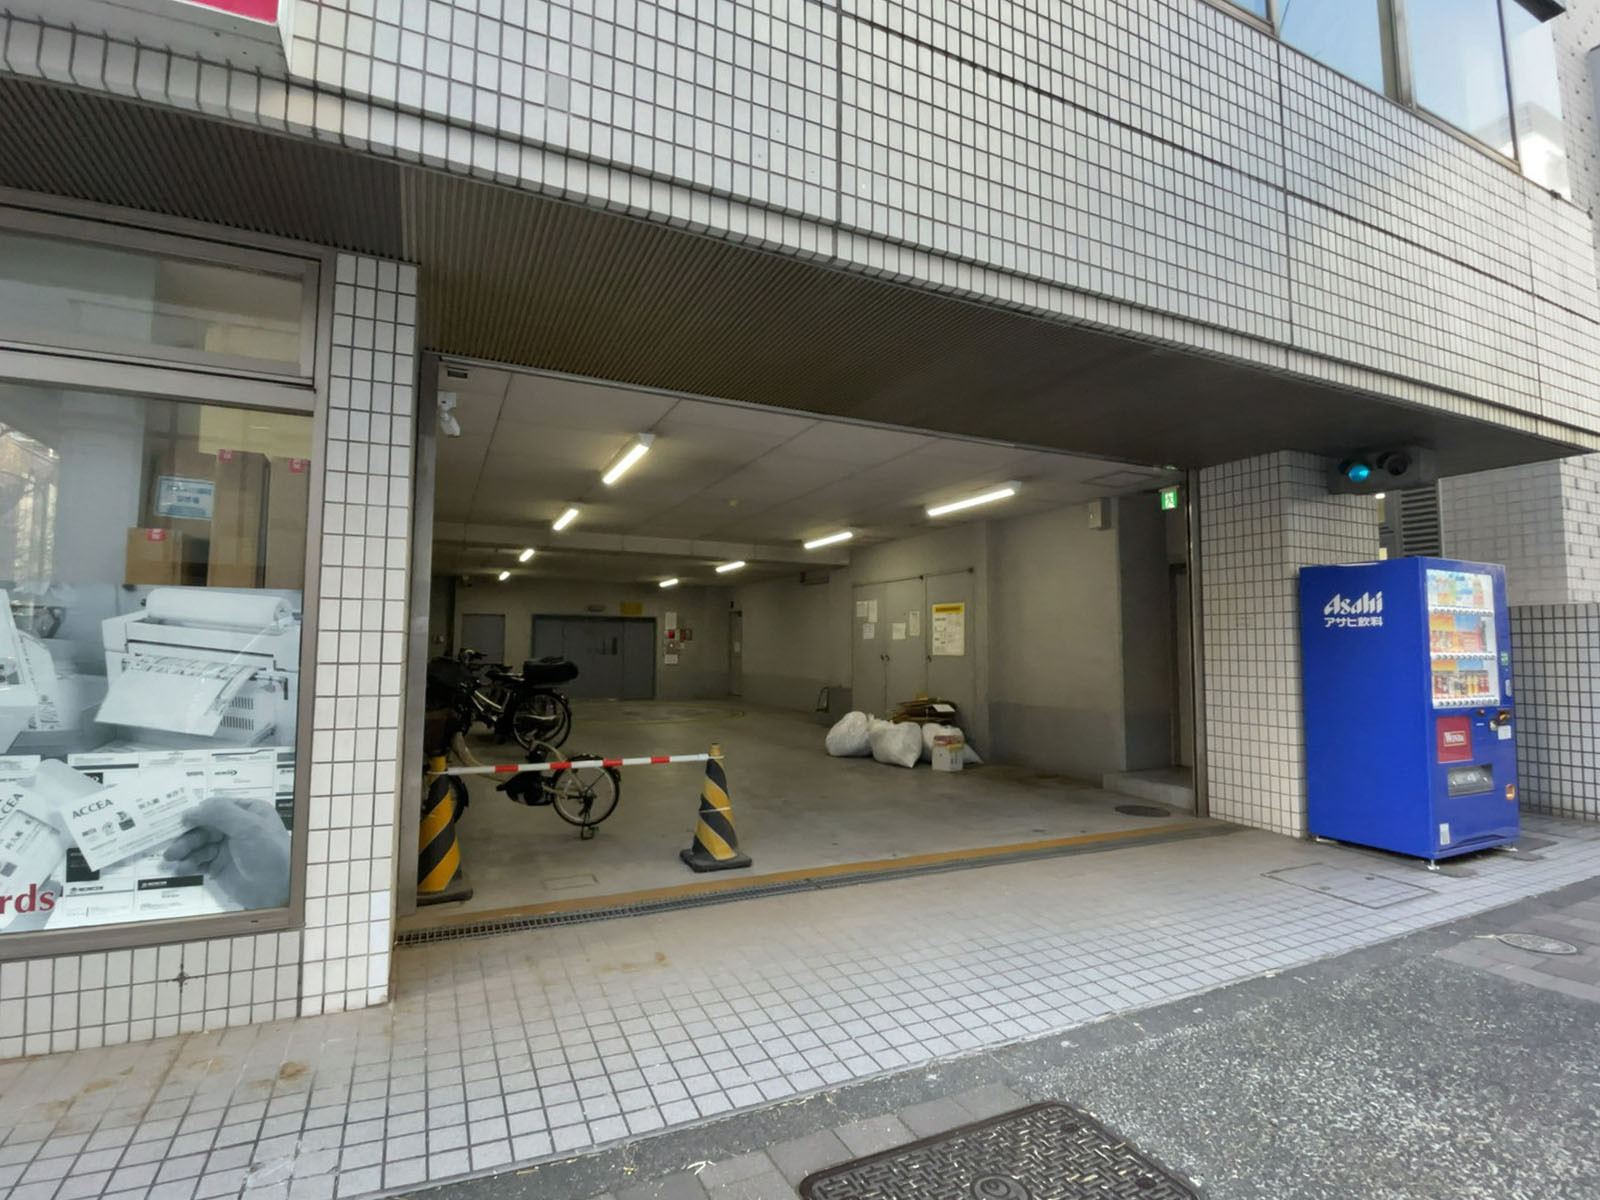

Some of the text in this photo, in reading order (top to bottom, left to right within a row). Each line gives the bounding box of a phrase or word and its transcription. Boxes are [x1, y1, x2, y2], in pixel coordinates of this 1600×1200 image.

[1324, 591, 1383, 615] Asahi
[1324, 616, 1383, 627] アサヒ飲料
[72, 798, 114, 819] ACCEA
